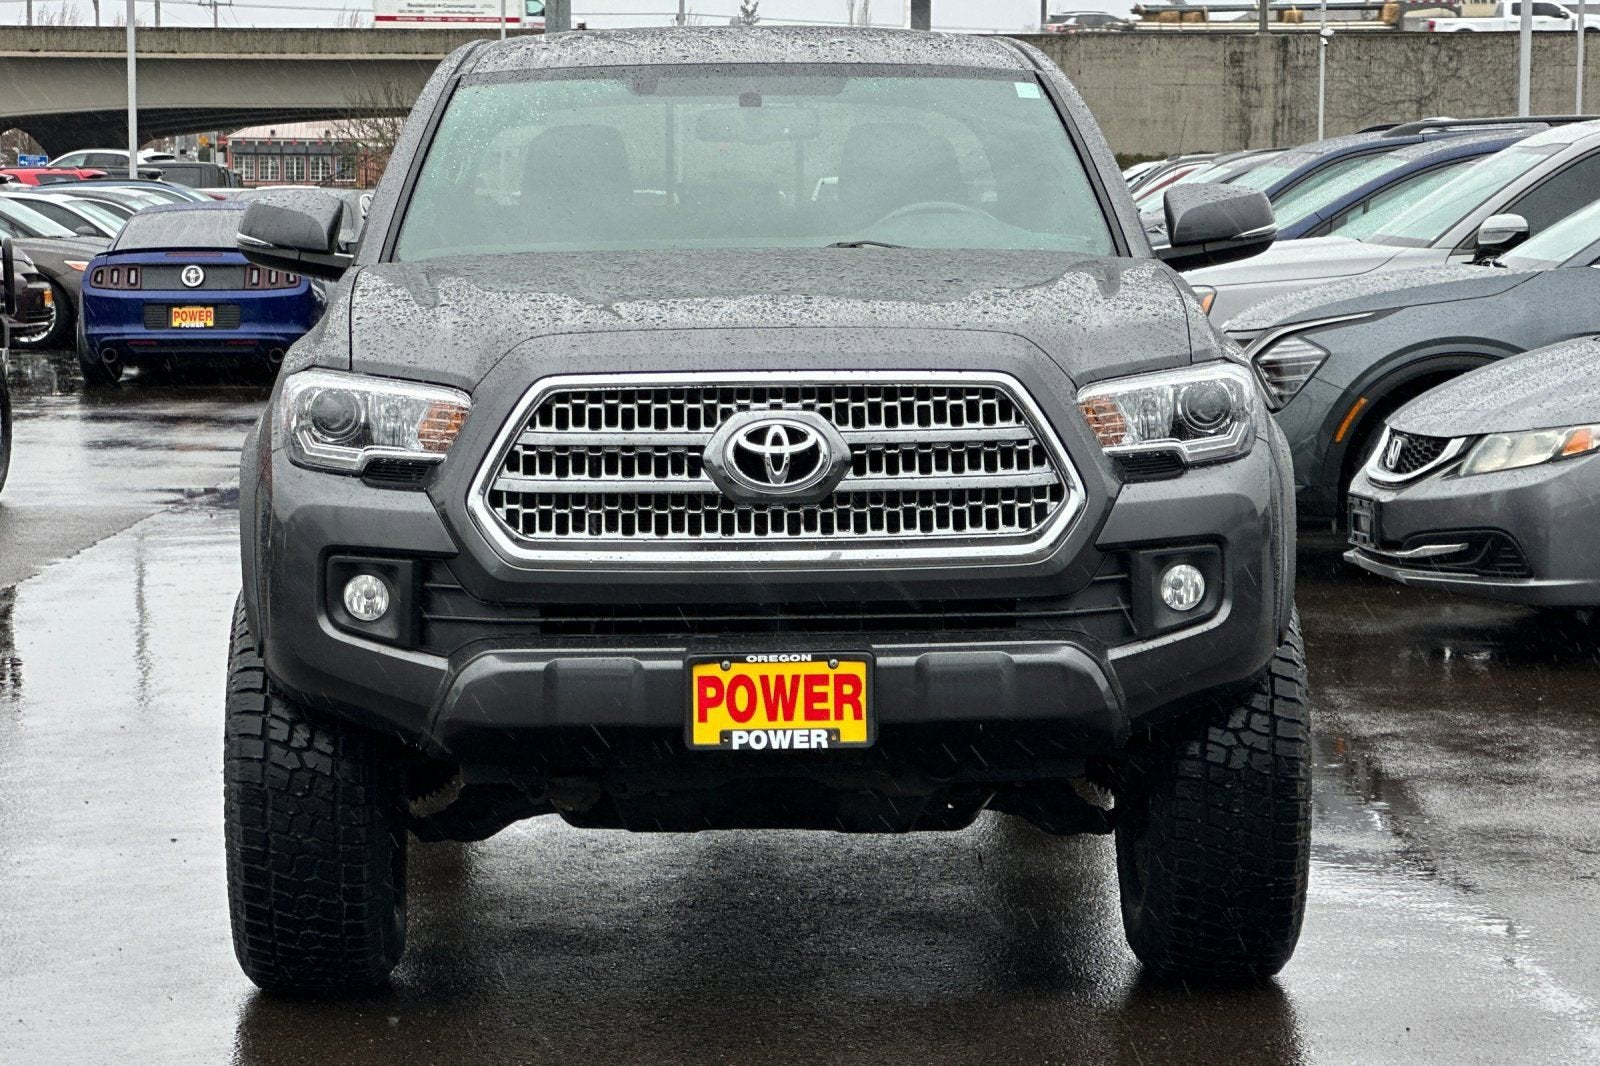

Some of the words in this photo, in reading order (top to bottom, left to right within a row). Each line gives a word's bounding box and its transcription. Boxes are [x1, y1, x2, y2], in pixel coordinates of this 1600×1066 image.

[173, 310, 213, 322] POWER
[746, 654, 812, 663] OREGON
[697, 673, 863, 723] POWER
[732, 729, 828, 750] POWER
